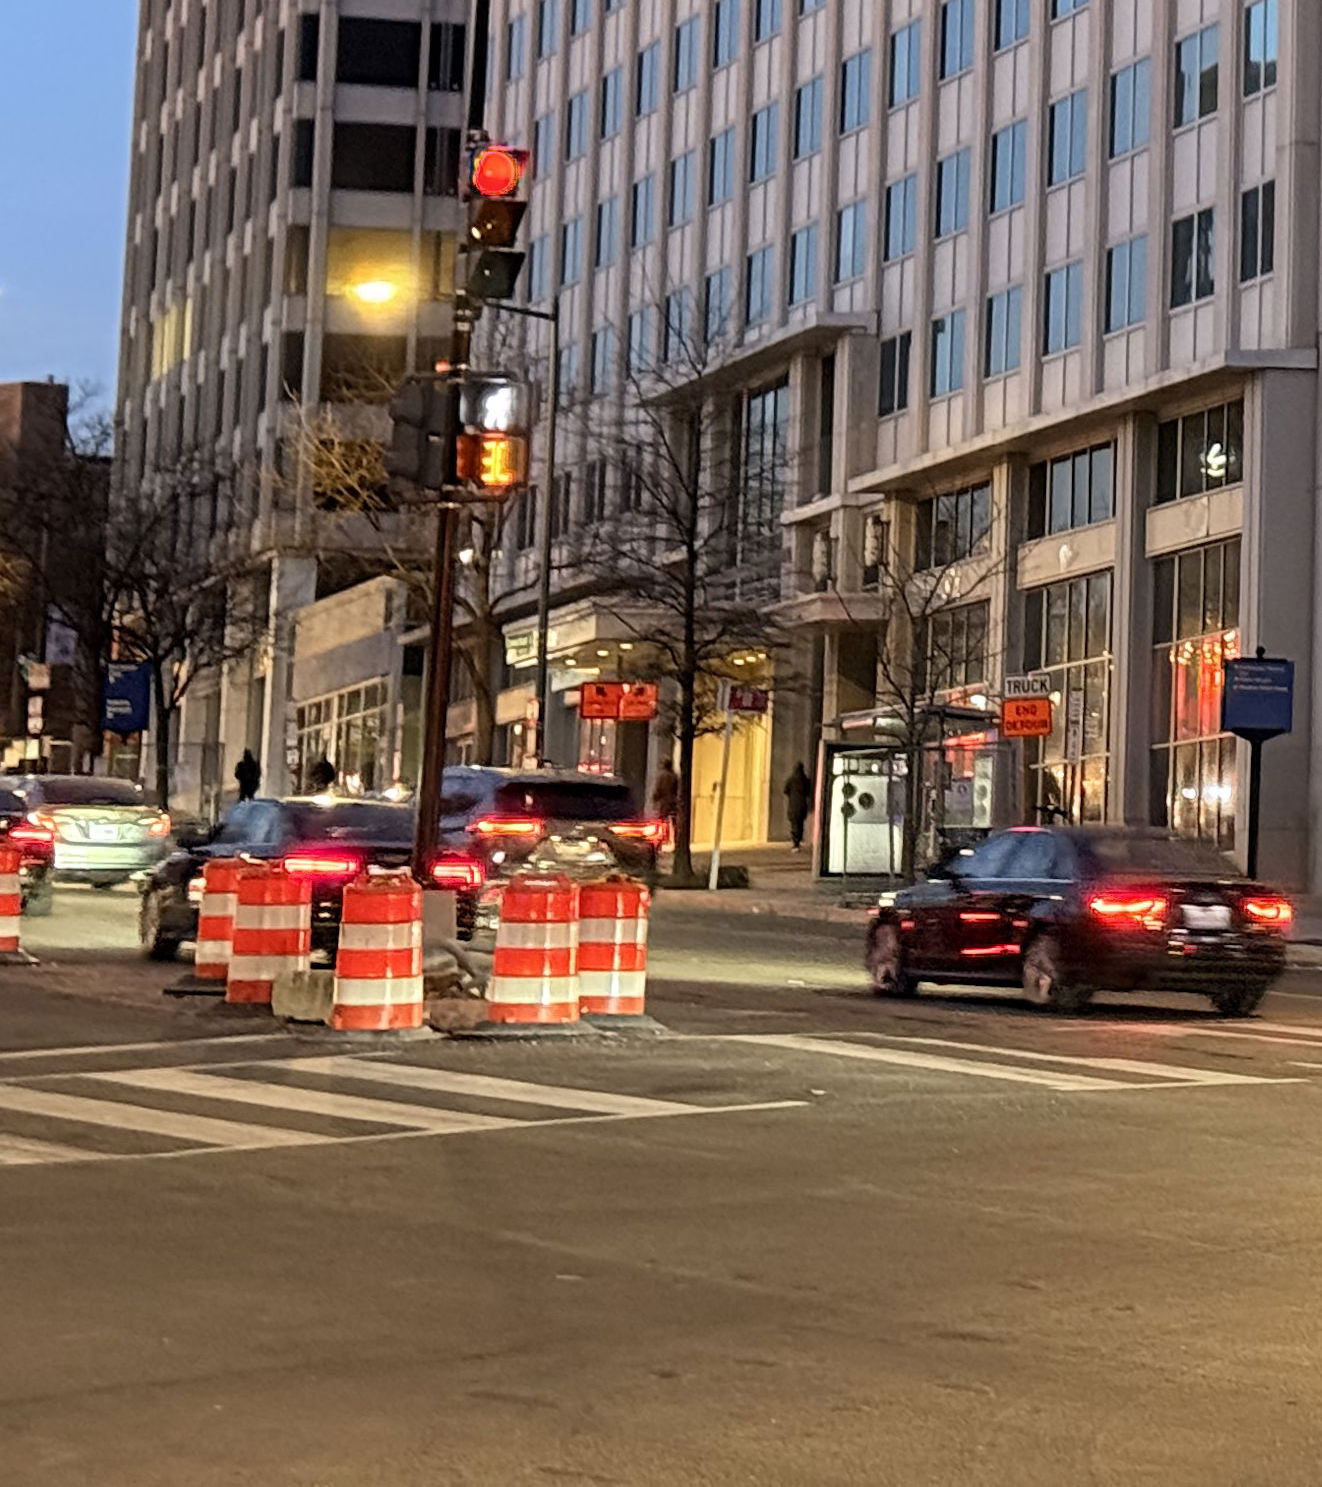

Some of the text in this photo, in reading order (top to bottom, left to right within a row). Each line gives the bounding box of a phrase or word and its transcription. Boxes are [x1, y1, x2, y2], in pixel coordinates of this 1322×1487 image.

[1006, 678, 1049, 694] TRUCK
[1015, 704, 1037, 717] END
[1006, 719, 1049, 731] DETOUR
